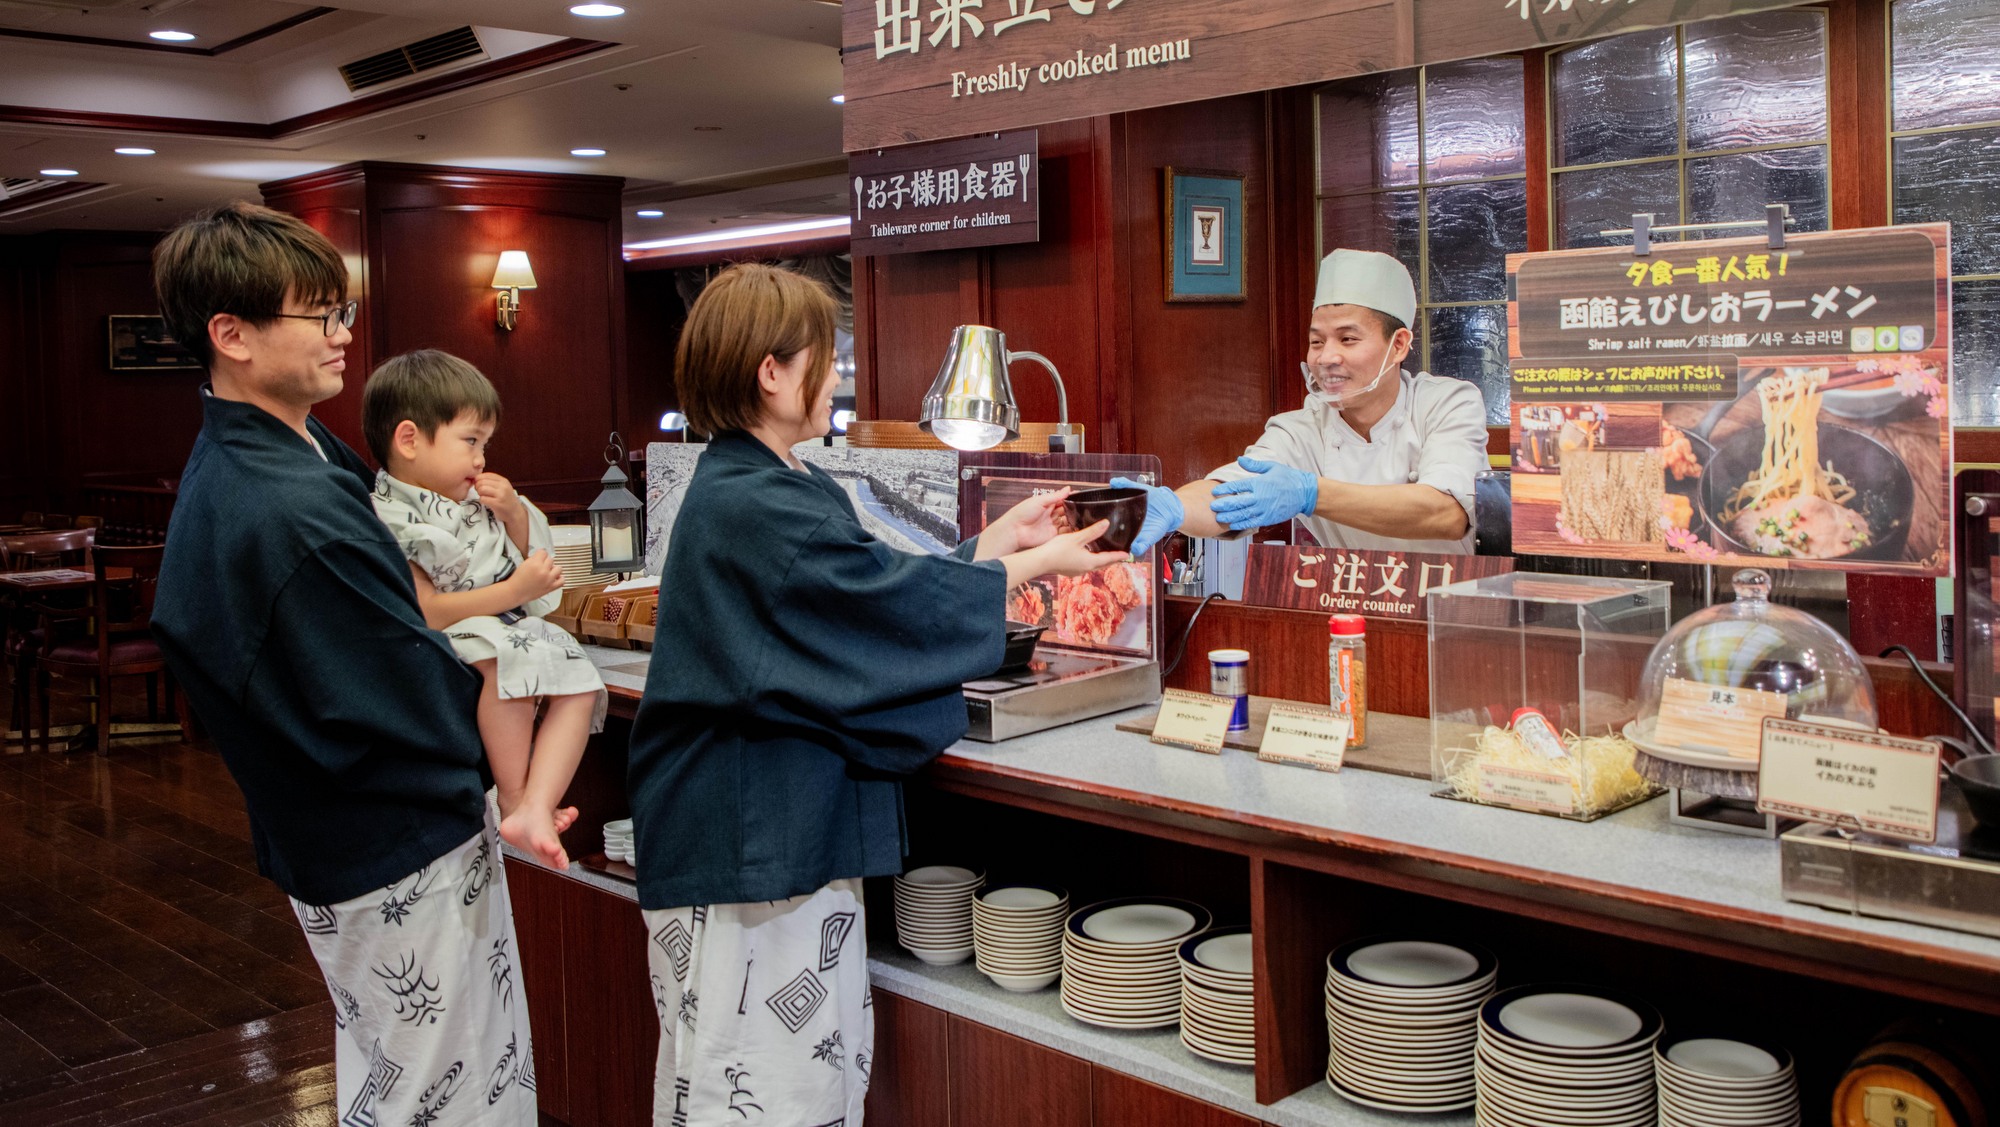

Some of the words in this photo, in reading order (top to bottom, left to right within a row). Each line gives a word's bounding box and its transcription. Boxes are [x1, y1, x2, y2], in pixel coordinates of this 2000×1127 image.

[951, 62, 1030, 98] Freshly
[1039, 44, 1118, 84] cooked
[1126, 38, 1190, 69] menu
[867, 160, 1017, 210] お子様用食器
[870, 222, 917, 237] Tableware
[920, 219, 950, 232] corner
[953, 215, 969, 229] for
[971, 212, 1011, 227] children
[1560, 285, 1877, 330] 函館えびしおラーメン
[1588, 338, 1623, 351] Shrimp
[1627, 337, 1652, 349] salt
[1791, 329, 1843, 345] 소금라면
[1293, 553, 1454, 599] ご注文口
[1320, 593, 1359, 611] Order
[1363, 601, 1415, 614] counter
[1710, 690, 1735, 705] 見本
